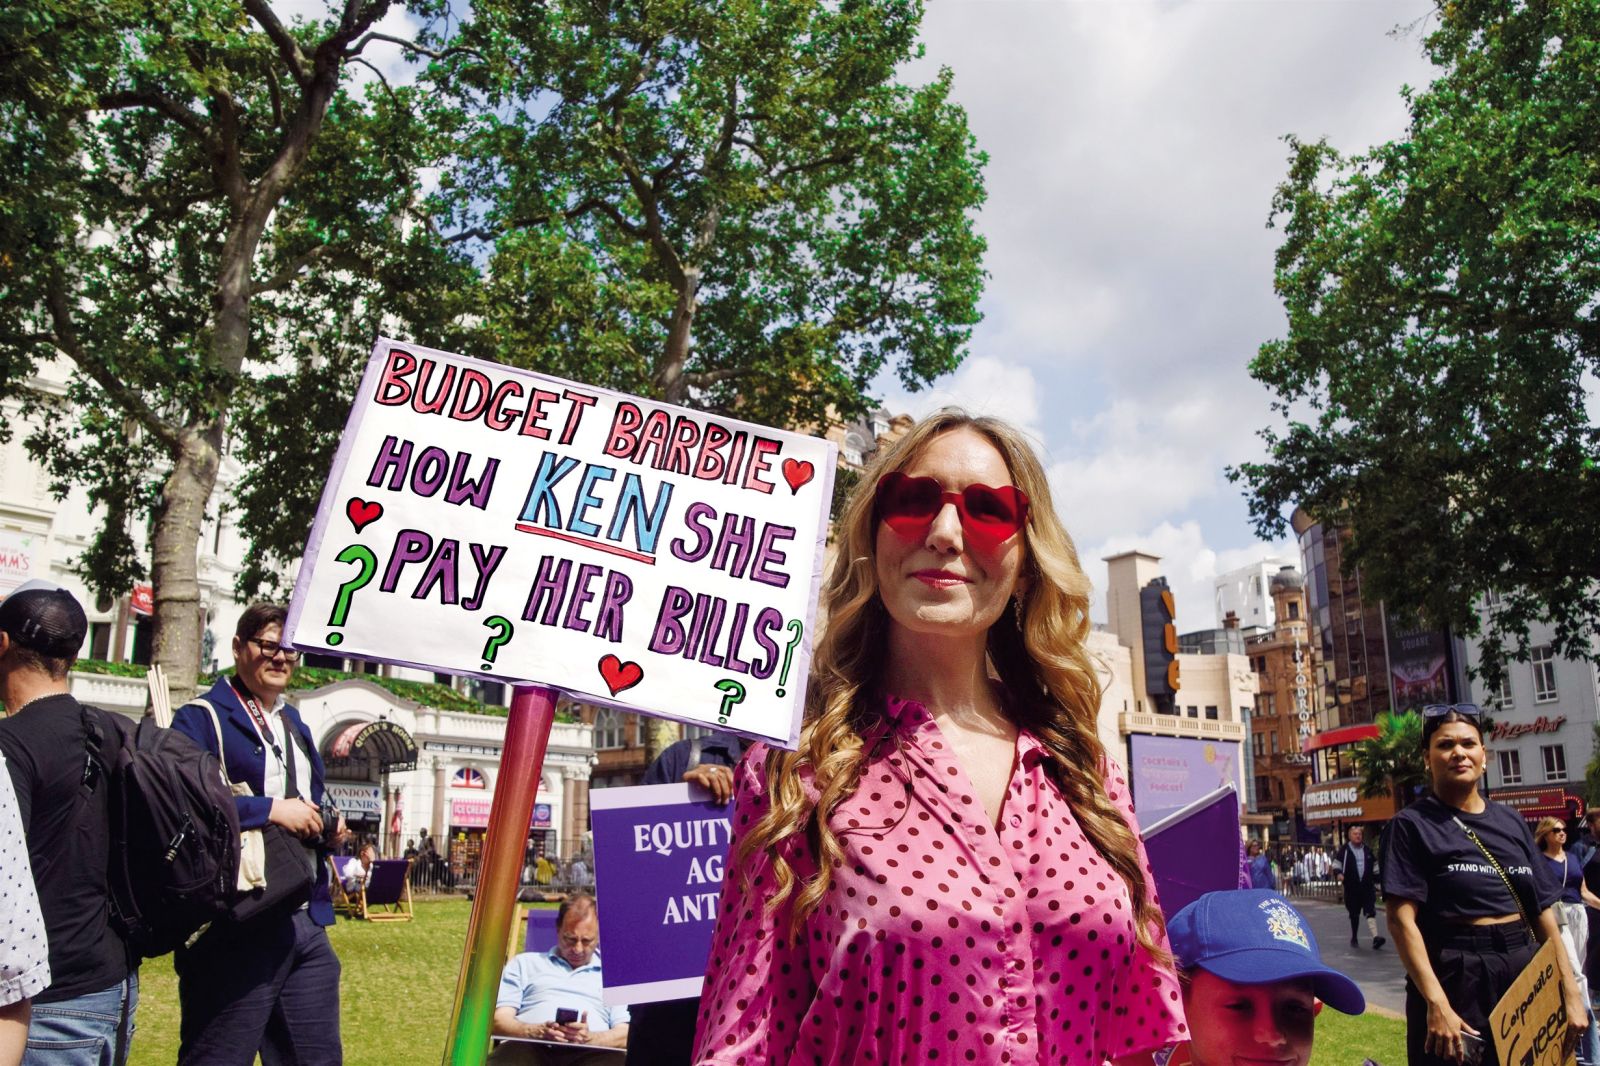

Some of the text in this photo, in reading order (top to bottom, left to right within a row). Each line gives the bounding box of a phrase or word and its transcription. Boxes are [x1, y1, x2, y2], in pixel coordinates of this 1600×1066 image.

[374, 349, 784, 495] BUDGET BARBIE
[366, 435, 797, 589] HOW KEN SHE
[380, 529, 508, 611] PAY
[521, 555, 634, 643] HER
[355, 722, 388, 748] QUEEN'S
[392, 725, 415, 751] HOUSE
[327, 787, 372, 798] LONDON
[1330, 787, 1358, 805] KING
[686, 855, 724, 885] AG
[1447, 863, 1478, 872] STAND
[1479, 864, 1498, 875] WITH
[662, 892, 721, 925] ANT
[1500, 963, 1554, 1041] Corporate
